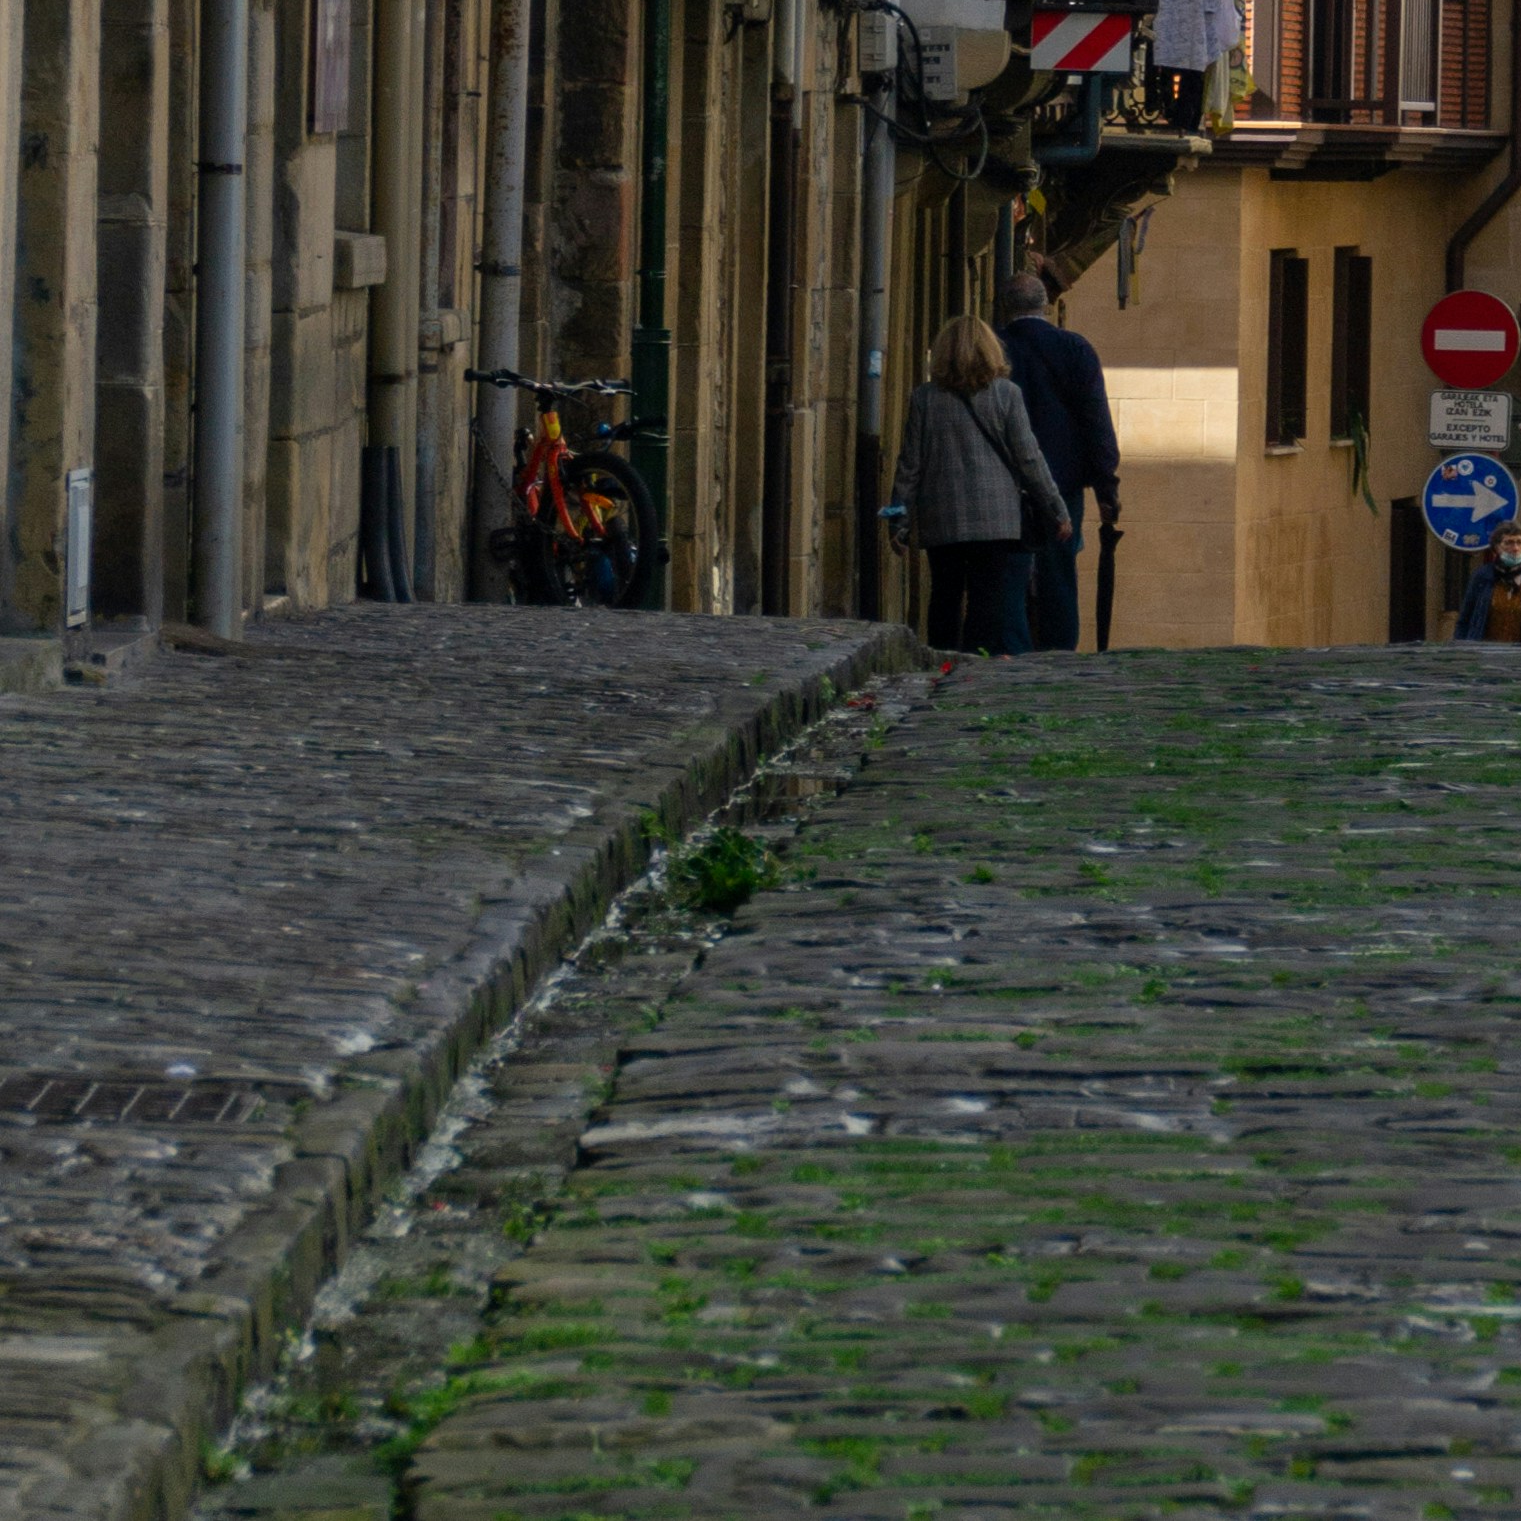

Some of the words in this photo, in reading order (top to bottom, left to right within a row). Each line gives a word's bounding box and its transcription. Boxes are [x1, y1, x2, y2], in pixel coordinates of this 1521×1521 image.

[1446, 407, 1468, 416] IZAN
[1472, 408, 1492, 417] EZIK
[1446, 423, 1491, 433] EXCEPTO
[1431, 433, 1468, 441] GARAJES
[1471, 434, 1477, 442] Y
[1480, 435, 1505, 443] HOTEL
